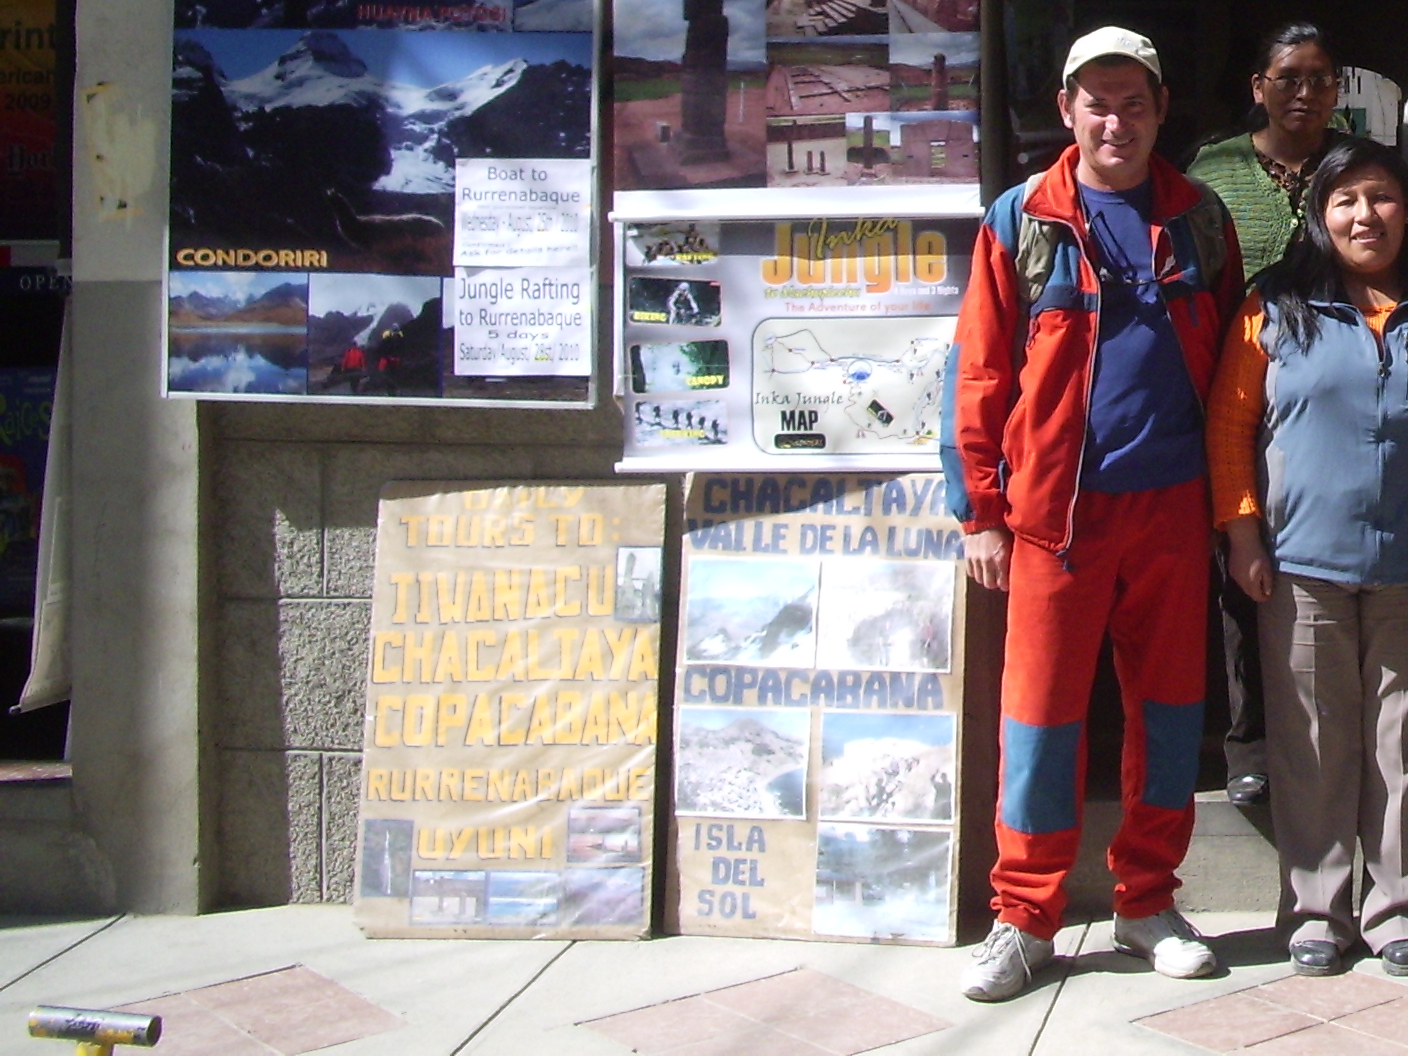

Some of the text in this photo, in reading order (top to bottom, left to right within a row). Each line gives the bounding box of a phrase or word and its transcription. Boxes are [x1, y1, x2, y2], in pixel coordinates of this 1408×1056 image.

[487, 166, 548, 182] Boat to
[461, 187, 581, 206] Rurrenabaque
[175, 248, 328, 268] CONDORIRI
[761, 220, 948, 294] Jungle
[459, 277, 581, 305] Jungle Rafting
[459, 308, 582, 329] to Rurrenabaque
[785, 302, 804, 312] The
[809, 302, 867, 312] Adventure
[871, 302, 882, 312] of
[885, 303, 909, 315] your
[487, 330, 549, 342] 5 days
[685, 375, 725, 386] CANOPY
[755, 390, 844, 412] Inka Jungle
[780, 409, 819, 431] MAP
[400, 514, 534, 548] TOURS
[686, 519, 966, 561] VALLE DE LA LUNA
[389, 564, 615, 625] TIWANACU
[372, 627, 659, 684] CHACALTAYA
[683, 667, 944, 711] COPACABANA
[374, 690, 659, 747] COPACABANA
[366, 766, 650, 803] RURRENABAQUE
[416, 825, 553, 861] UYUNI
[693, 822, 766, 853] ISLA
[711, 856, 766, 888] DEL
[697, 888, 757, 920] SOL
